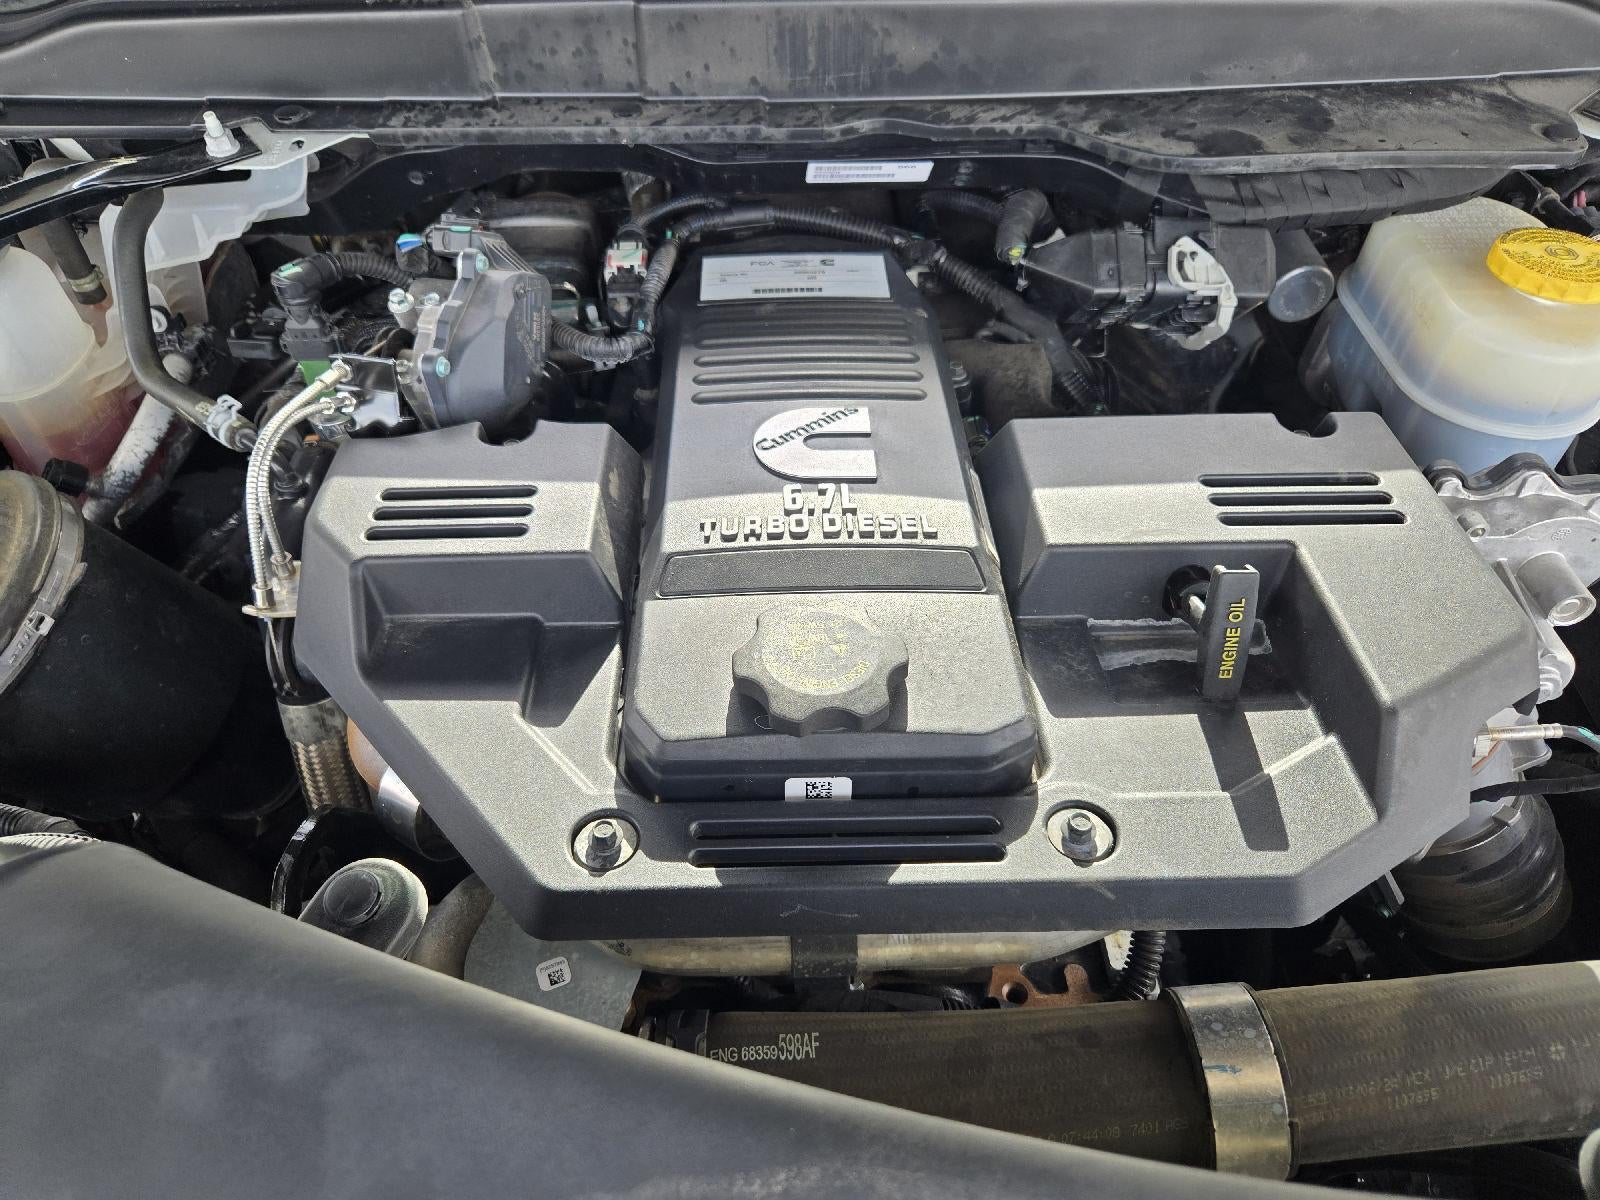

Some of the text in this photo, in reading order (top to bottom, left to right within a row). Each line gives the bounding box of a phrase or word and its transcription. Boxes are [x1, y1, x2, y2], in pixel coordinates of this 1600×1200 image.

[755, 408, 859, 451] Cummins
[783, 482, 858, 515] 6.7L
[700, 512, 938, 542] TURBO DIESEL
[1218, 598, 1246, 679] ENGINE OIL
[710, 1047, 738, 1062] ENG
